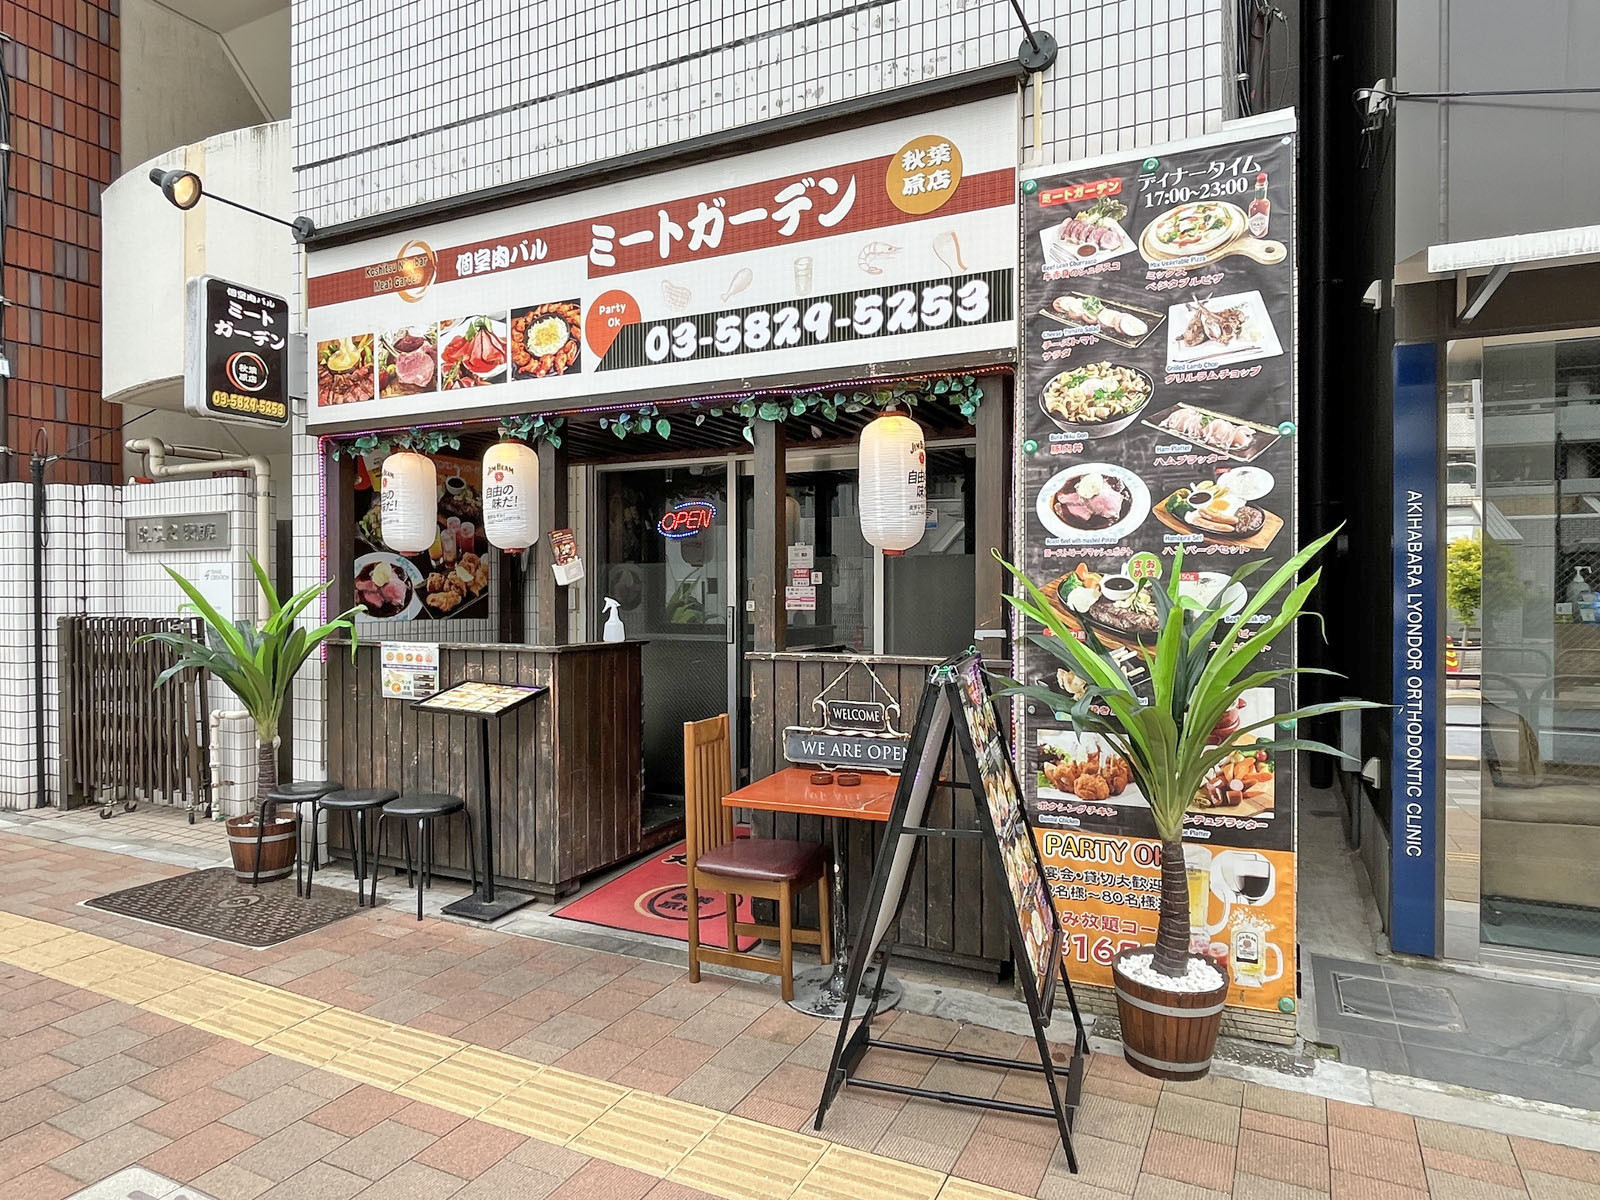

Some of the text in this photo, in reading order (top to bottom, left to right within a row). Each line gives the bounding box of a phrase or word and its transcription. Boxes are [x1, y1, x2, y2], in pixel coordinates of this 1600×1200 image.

[902, 143, 952, 172] 秋葉
[902, 170, 952, 196] 原店
[1137, 156, 1262, 192] ディナータイム
[1041, 181, 1120, 204] ミートガーデン
[588, 173, 857, 268] ミートガーデン
[455, 238, 548, 277] 個室肉バル
[373, 279, 393, 292] Meat
[1145, 268, 1188, 281] ミックス
[227, 300, 275, 327] ミート
[599, 302, 626, 318] Party
[608, 315, 621, 329] Ok
[644, 279, 991, 363] 03-5829-5253
[214, 319, 285, 351] ガーデン
[212, 391, 285, 417] 03-5829-5253
[496, 462, 514, 474] BEAM
[485, 484, 514, 499] 自由の
[491, 495, 518, 509] 味だ!
[661, 508, 714, 532] OPEN
[1162, 543, 1250, 556] ハバーグセット
[1405, 490, 1423, 858] AKIHABARA LYONDOR ORTHODONTIC CLINIC
[832, 707, 881, 723] WELCOME
[801, 740, 826, 757] WE
[830, 745, 862, 759] ARE
[1044, 833, 1129, 864] PARTY
